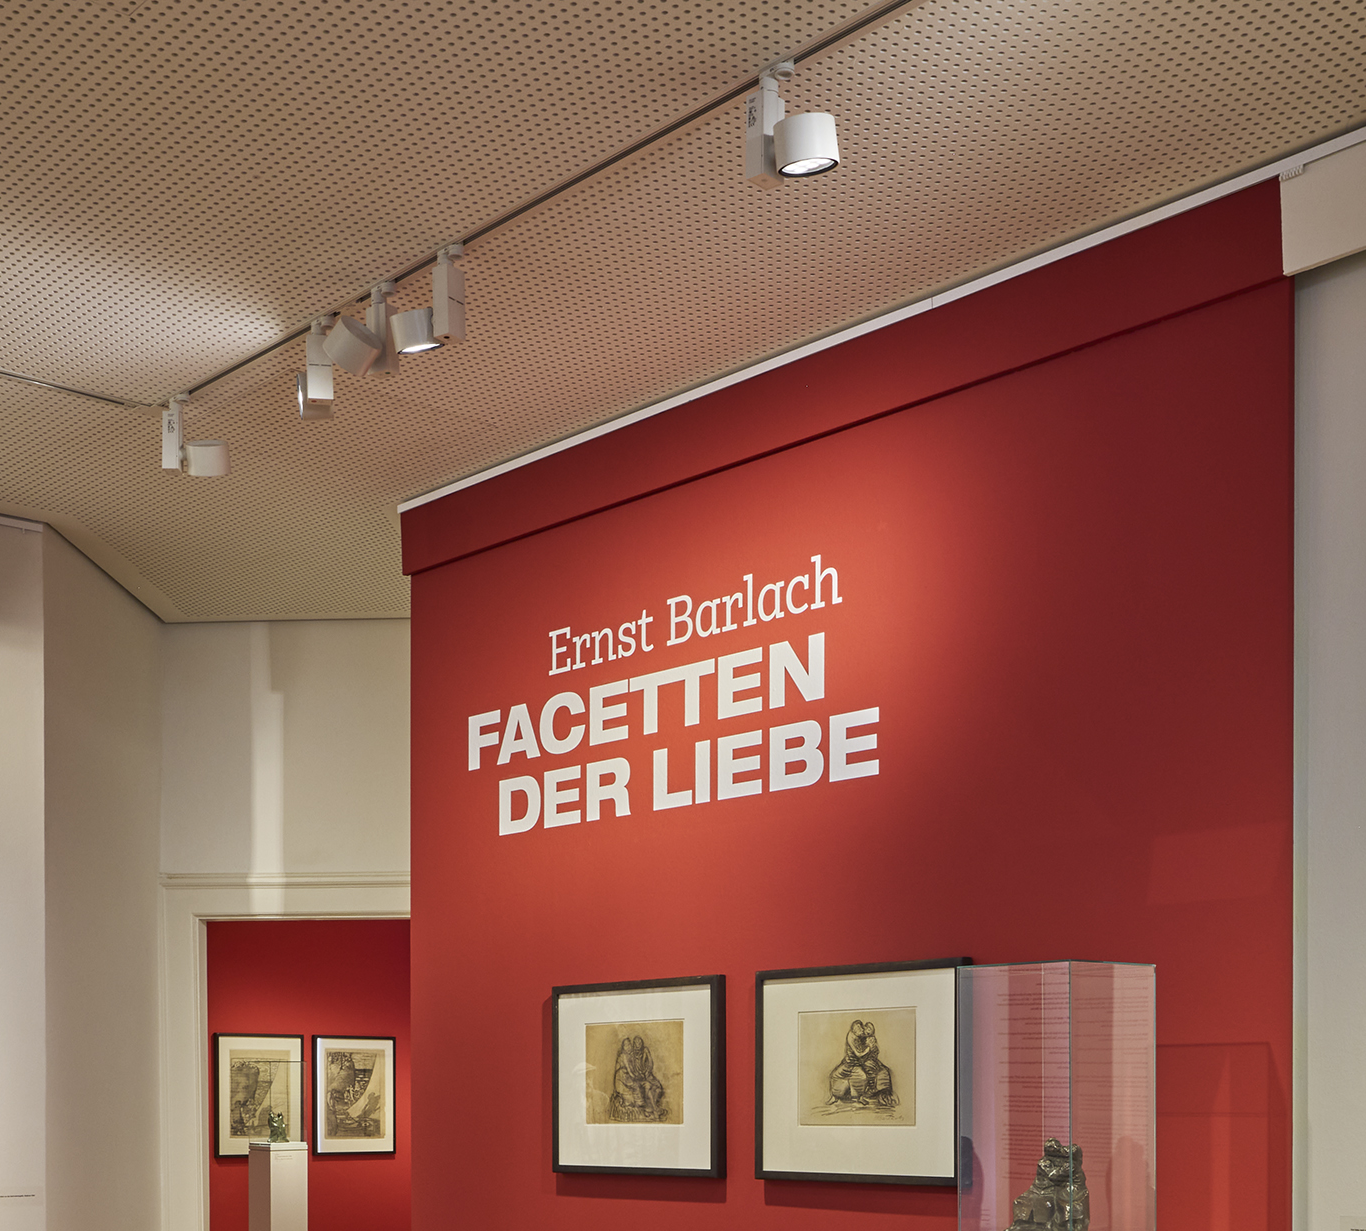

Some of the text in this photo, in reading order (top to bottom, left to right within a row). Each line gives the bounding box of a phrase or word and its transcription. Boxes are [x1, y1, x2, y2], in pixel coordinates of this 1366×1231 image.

[549, 554, 842, 676] Ernst Barlach
[468, 632, 825, 771] FACETTEN
[499, 707, 879, 836] DER LIEBE
